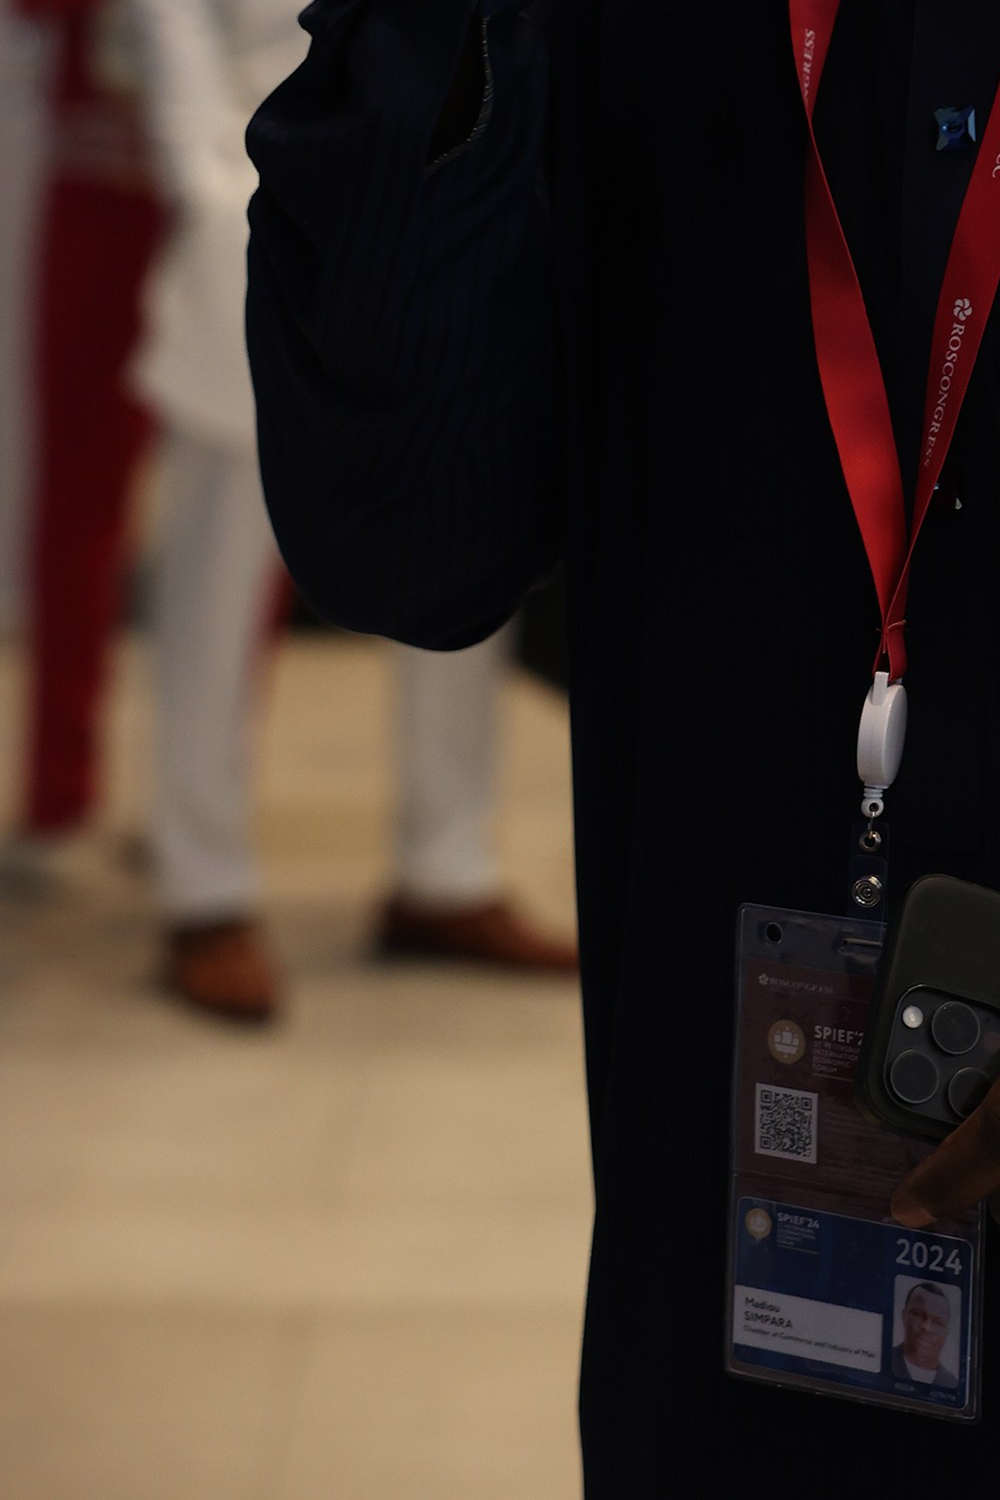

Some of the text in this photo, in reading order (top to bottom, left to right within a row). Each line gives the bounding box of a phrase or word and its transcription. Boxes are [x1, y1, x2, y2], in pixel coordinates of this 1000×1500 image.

[924, 322, 965, 467] ROSCONGRESS
[895, 1238, 962, 1276] 2024
[744, 1311, 793, 1329] SIMPARA
